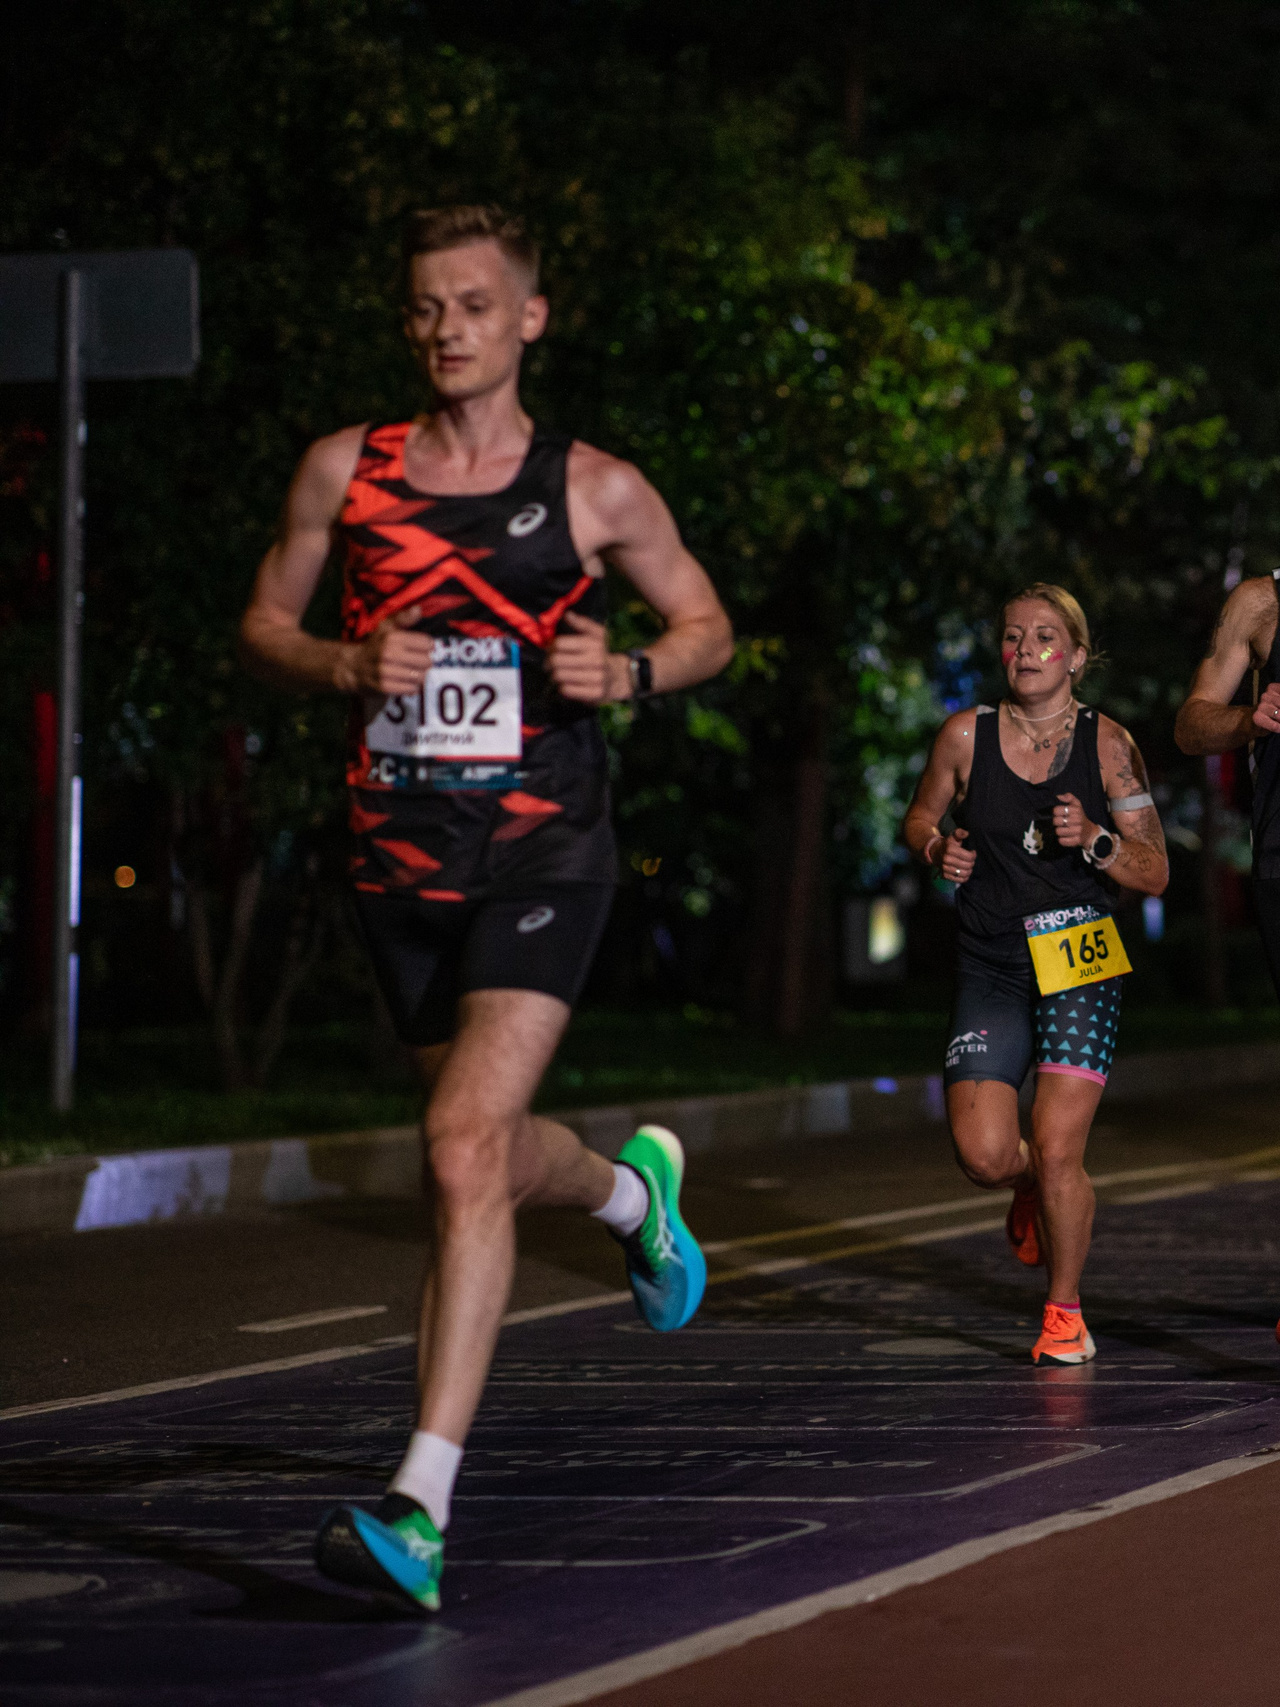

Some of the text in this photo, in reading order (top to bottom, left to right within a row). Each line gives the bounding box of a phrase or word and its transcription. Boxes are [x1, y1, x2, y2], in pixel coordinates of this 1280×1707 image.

[1058, 929, 1109, 968] 165
[1078, 964, 1104, 978] JULIA
[946, 1044, 988, 1059] AFTER
